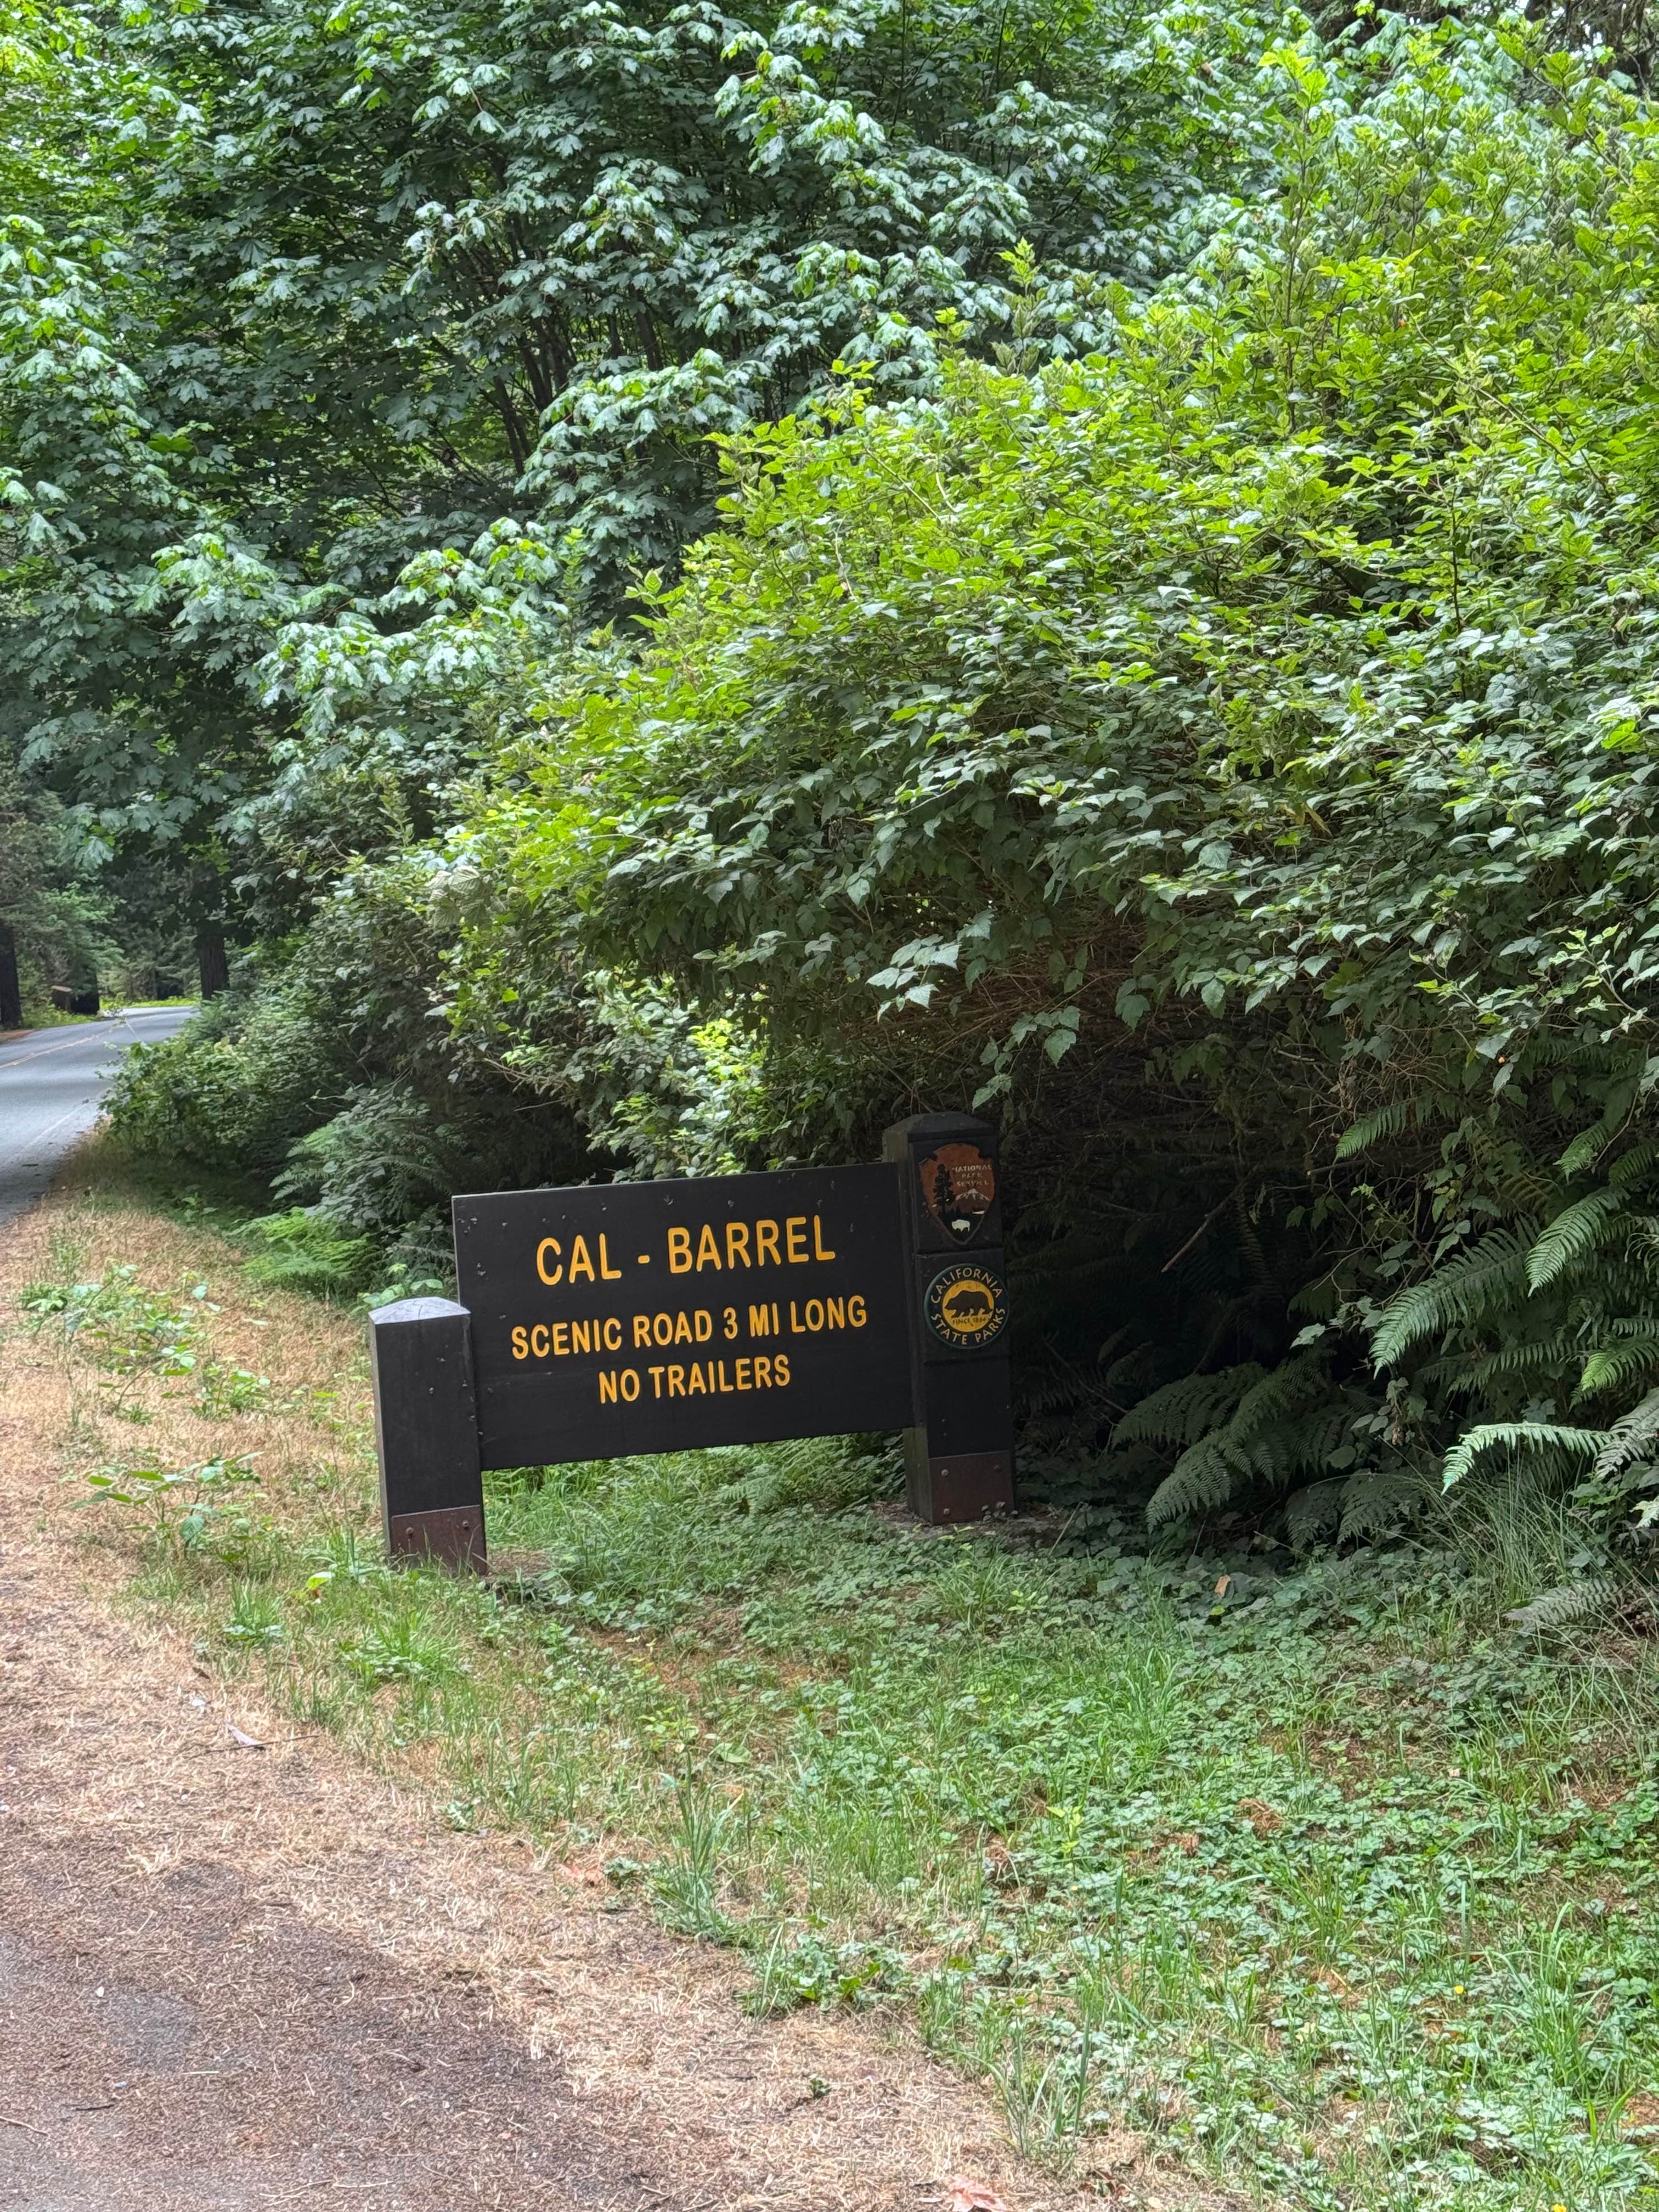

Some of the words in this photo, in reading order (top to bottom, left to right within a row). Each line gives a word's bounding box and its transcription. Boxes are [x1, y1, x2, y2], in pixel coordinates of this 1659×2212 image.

[536, 1233, 622, 1286] CAL
[637, 1255, 650, 1265] -
[667, 1215, 836, 1274] BARREL
[930, 1267, 1003, 1304] CALIFORNIA
[511, 1317, 622, 1360] SCENIC
[633, 1310, 713, 1348] ROAD
[723, 1307, 738, 1340] 3
[748, 1302, 780, 1338] MI
[790, 1295, 867, 1333] LONG
[930, 1313, 968, 1345] STATE
[974, 1308, 1006, 1342] PARKS
[598, 1368, 641, 1404] NO
[648, 1354, 791, 1398] TRAILERS
